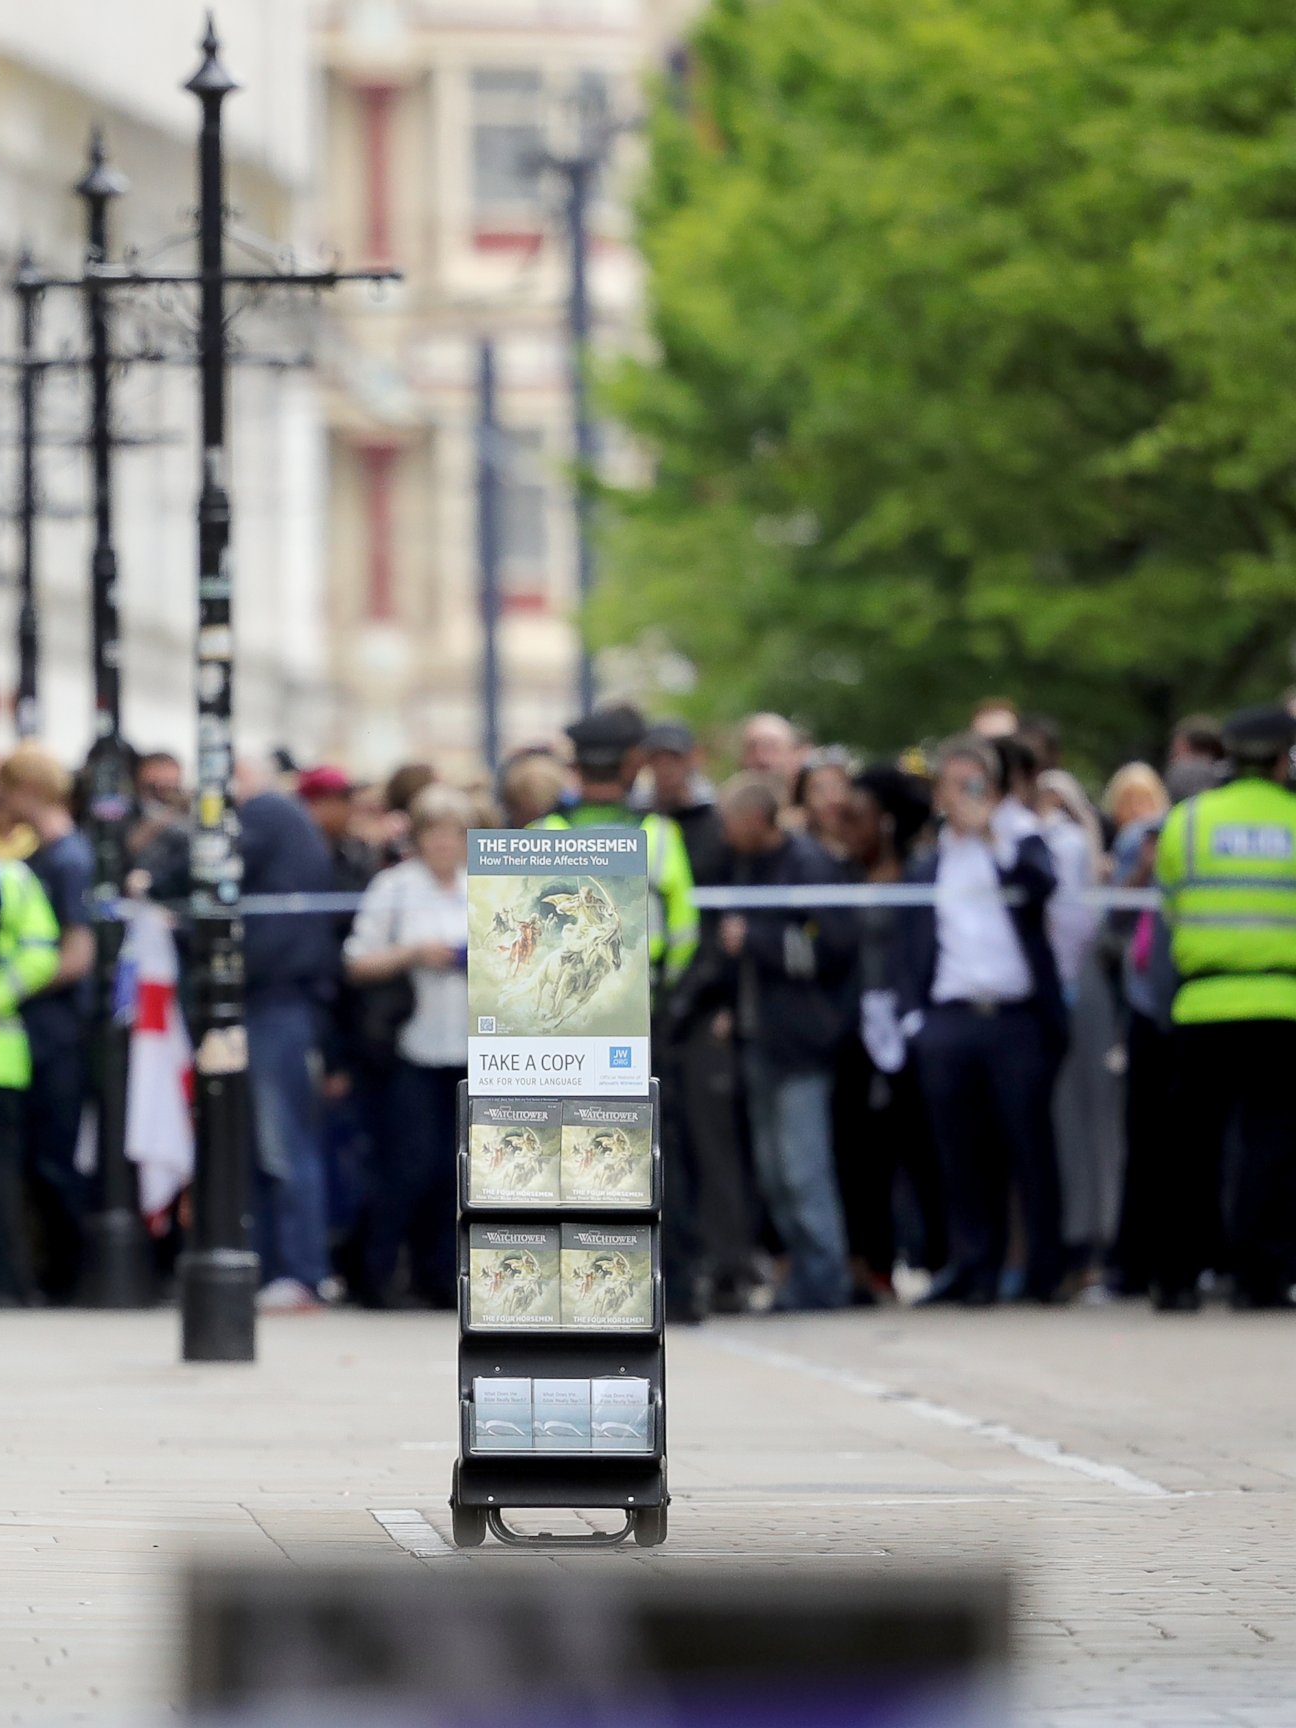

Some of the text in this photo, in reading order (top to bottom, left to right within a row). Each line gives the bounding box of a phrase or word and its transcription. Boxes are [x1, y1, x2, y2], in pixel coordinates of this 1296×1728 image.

[478, 839, 638, 853] THE FOUR HORSEMEN
[480, 856, 608, 866] How Their Ride Affects You
[613, 1049, 628, 1058] JW
[480, 1054, 586, 1072] TAKE A COPY
[479, 1077, 582, 1086] ASK FOR YOUR LANGUAGE
[489, 1108, 548, 1120] WATCHTOWER
[579, 1108, 638, 1120] WATCHTOWER
[487, 1232, 546, 1242] WATCHTOWER
[578, 1233, 638, 1244] WATCHTOWER
